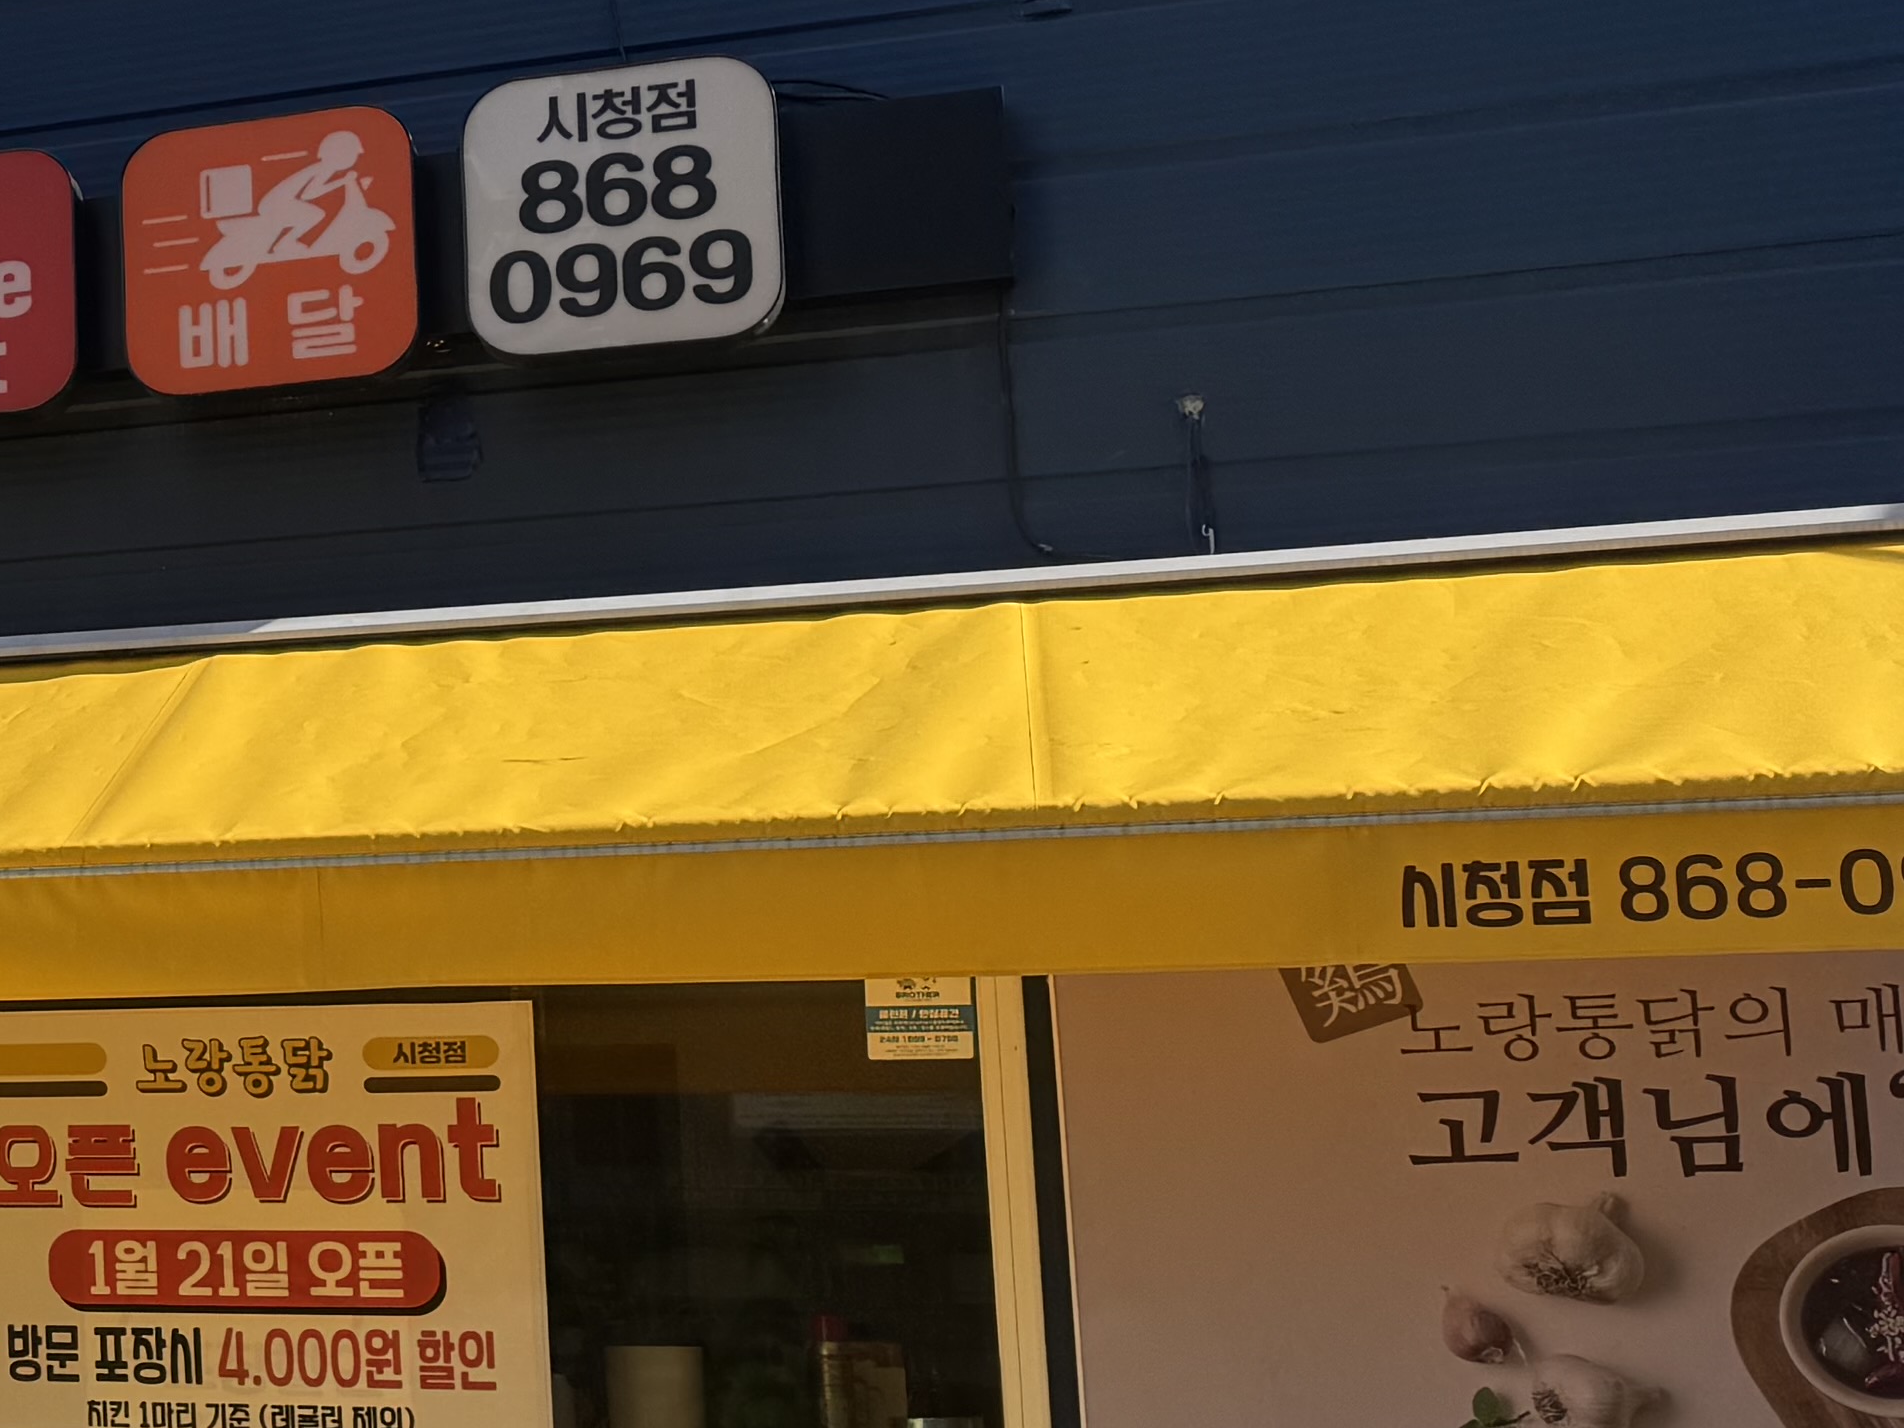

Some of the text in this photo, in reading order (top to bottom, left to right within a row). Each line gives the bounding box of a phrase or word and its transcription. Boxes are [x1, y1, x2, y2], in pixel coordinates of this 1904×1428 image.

[537, 78, 700, 146] 시청점
[518, 145, 717, 235] 868
[489, 230, 754, 325] 0969
[1401, 848, 1904, 928] 시청점 868-0
[392, 1040, 468, 1067] 시청점
[1400, 987, 1792, 1062] 노랑통닭의
[134, 1034, 333, 1098] 노랑통닭
[165, 1097, 502, 1206] event
[88, 1240, 405, 1300] 1월 21일 오픈
[7, 1324, 498, 1392] 방문 포장시 4.000원 할인
[87, 1399, 131, 1428] 치킨
